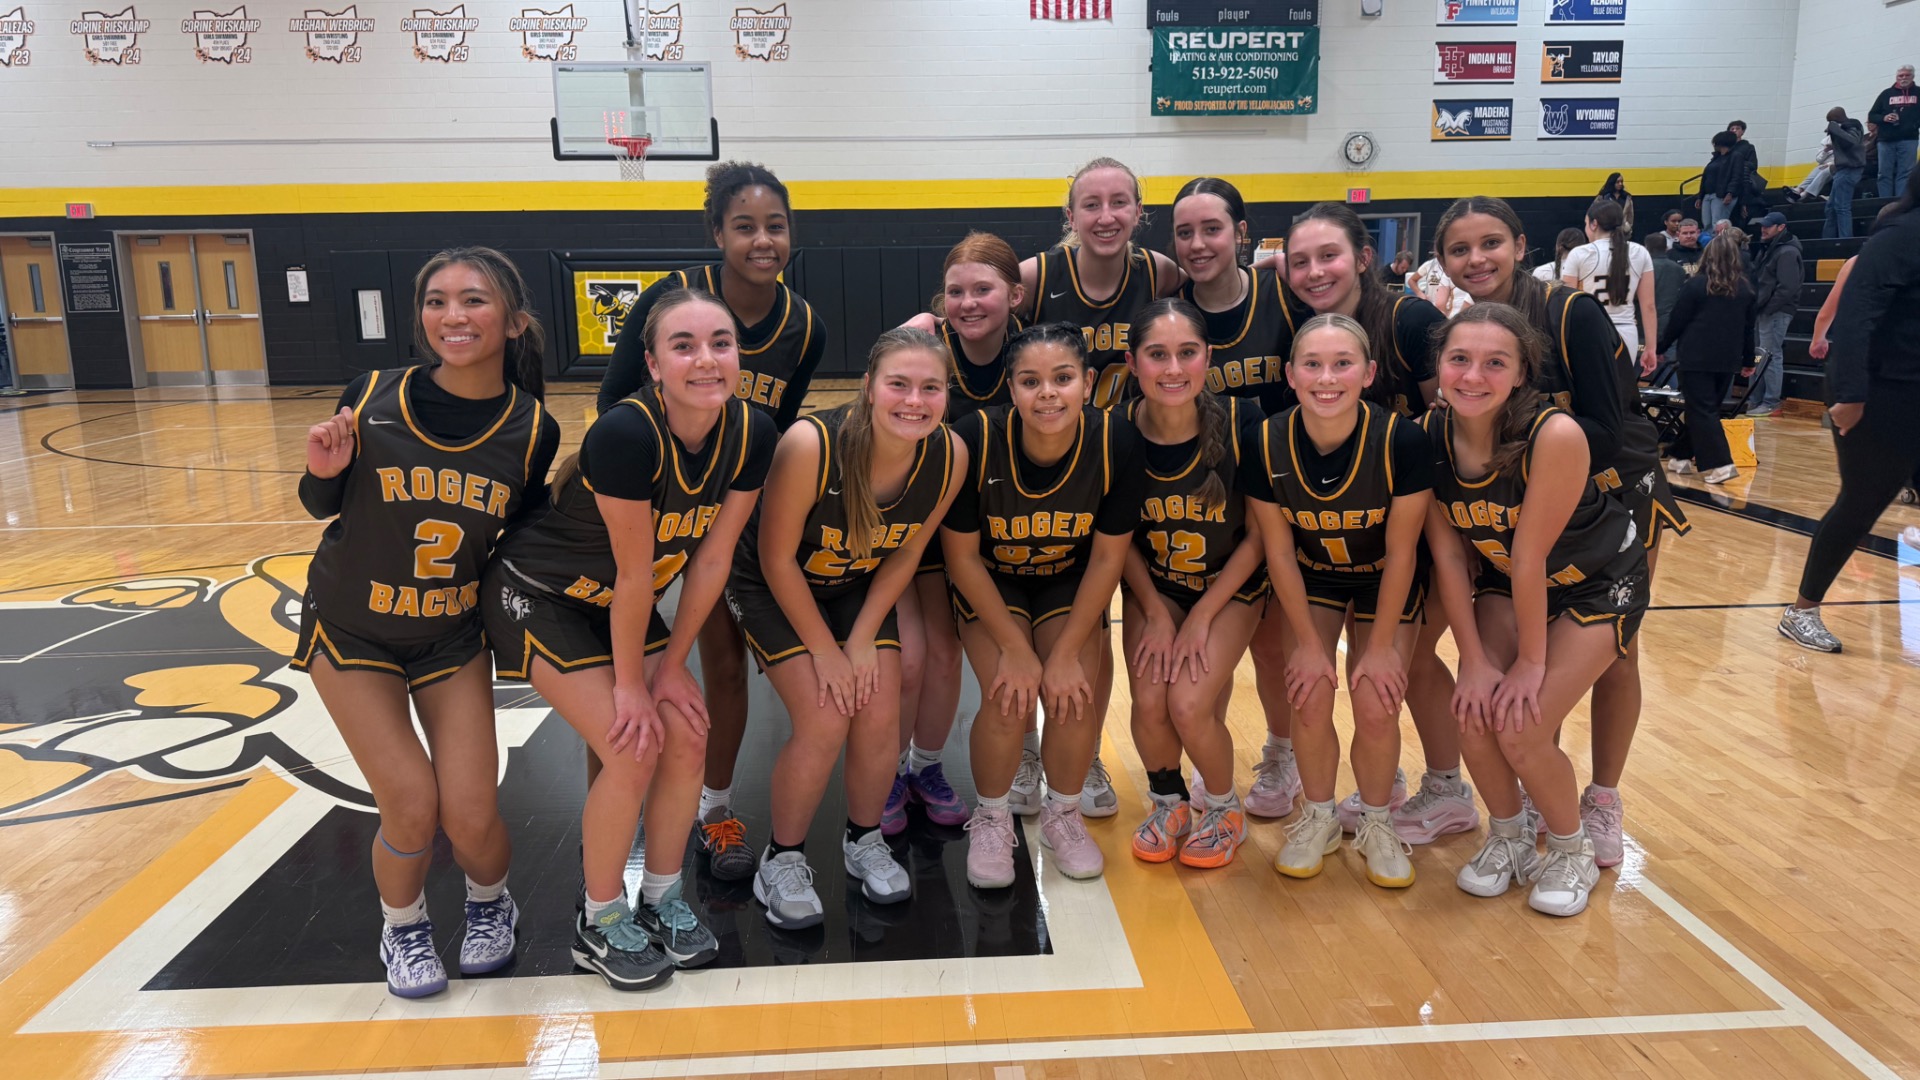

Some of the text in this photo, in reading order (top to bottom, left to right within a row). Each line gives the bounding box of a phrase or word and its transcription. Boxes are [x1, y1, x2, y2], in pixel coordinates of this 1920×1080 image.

[1156, 9, 1179, 22] fouls
[1218, 8, 1250, 23] player
[1289, 8, 1312, 21] fouls
[1593, 7, 1623, 15] BLUE DEVILS
[71, 20, 149, 33] CORINE RIESKAMP
[182, 19, 260, 32] CORINE RIESKAMP
[289, 19, 375, 32] MEGHAN WERBRICH
[401, 18, 479, 31] CORINE RIESKAMP
[510, 18, 587, 31] CORINE RIESKAMP
[649, 17, 682, 30] SAVAGE
[730, 17, 791, 30] GABBY FENTON
[1169, 32, 1304, 49] REUPERT
[1169, 52, 1299, 62] HEATING & AIR CONDITIONING
[1468, 53, 1512, 64] INDIAN HILL
[1592, 51, 1620, 63] TAYLOR
[1192, 66, 1278, 80] 513-922-5050
[1203, 83, 1267, 96] reupert.com
[1174, 100, 1295, 110] PROUD SUPPORTER OF THE YELLOWJACKETS
[1474, 107, 1509, 118] MADEIRA
[1576, 109, 1615, 120] WYOMING
[1482, 119, 1508, 127] MUSTANGS
[70, 204, 87, 217] EXIT
[1206, 355, 1282, 393] OGER
[376, 466, 511, 519] ROGER
[986, 510, 1094, 540] ROGER
[413, 518, 465, 578] 2
[1147, 529, 1206, 573] 12
[1320, 537, 1352, 564] 1
[368, 580, 480, 618] BACON
